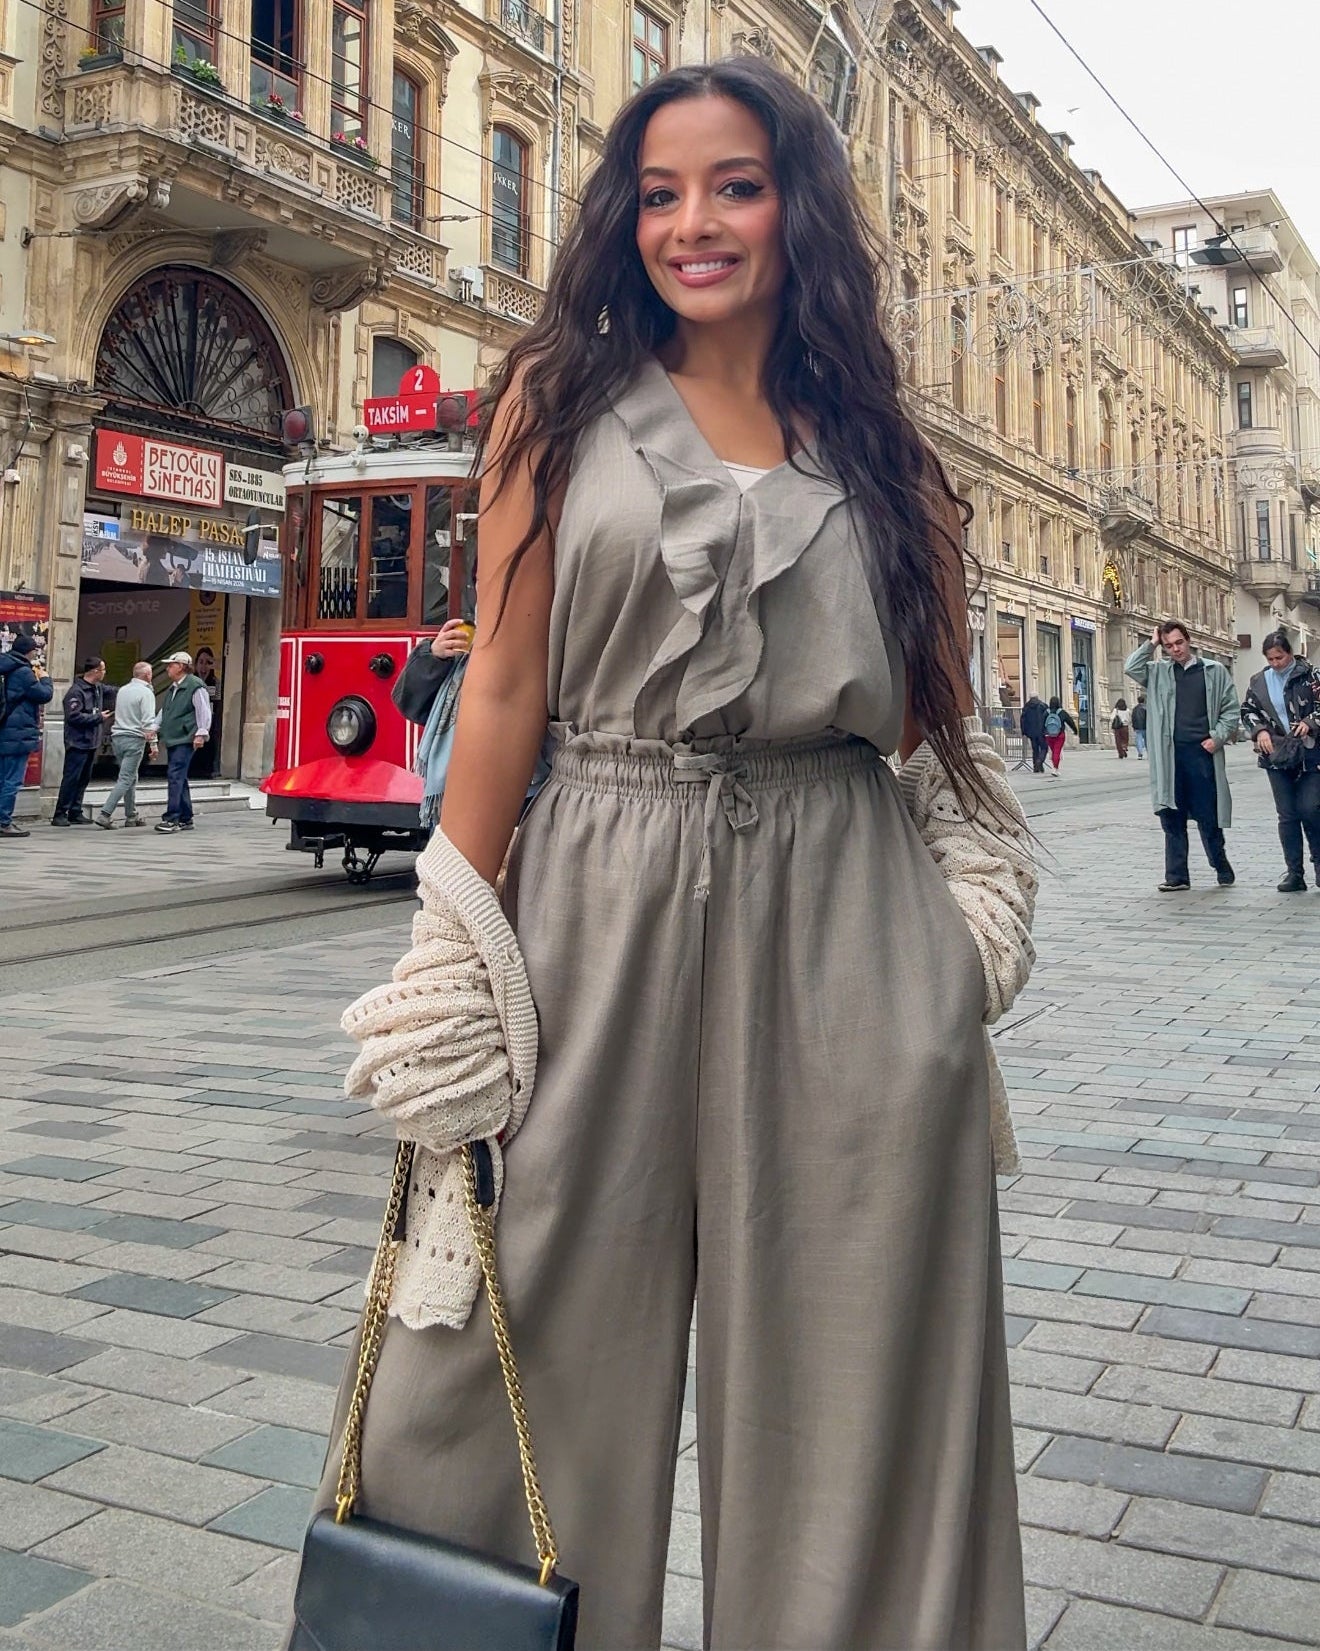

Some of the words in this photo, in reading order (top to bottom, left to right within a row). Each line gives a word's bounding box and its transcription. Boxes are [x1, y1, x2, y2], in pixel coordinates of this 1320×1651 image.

[414, 369, 424, 391] 2
[368, 401, 410, 426] TAKSİM
[149, 447, 217, 479] BEYOĞLU
[148, 469, 216, 500] SİNEMASI
[228, 485, 284, 507] ORTAOYUNCULAR
[131, 508, 192, 537] HALEP
